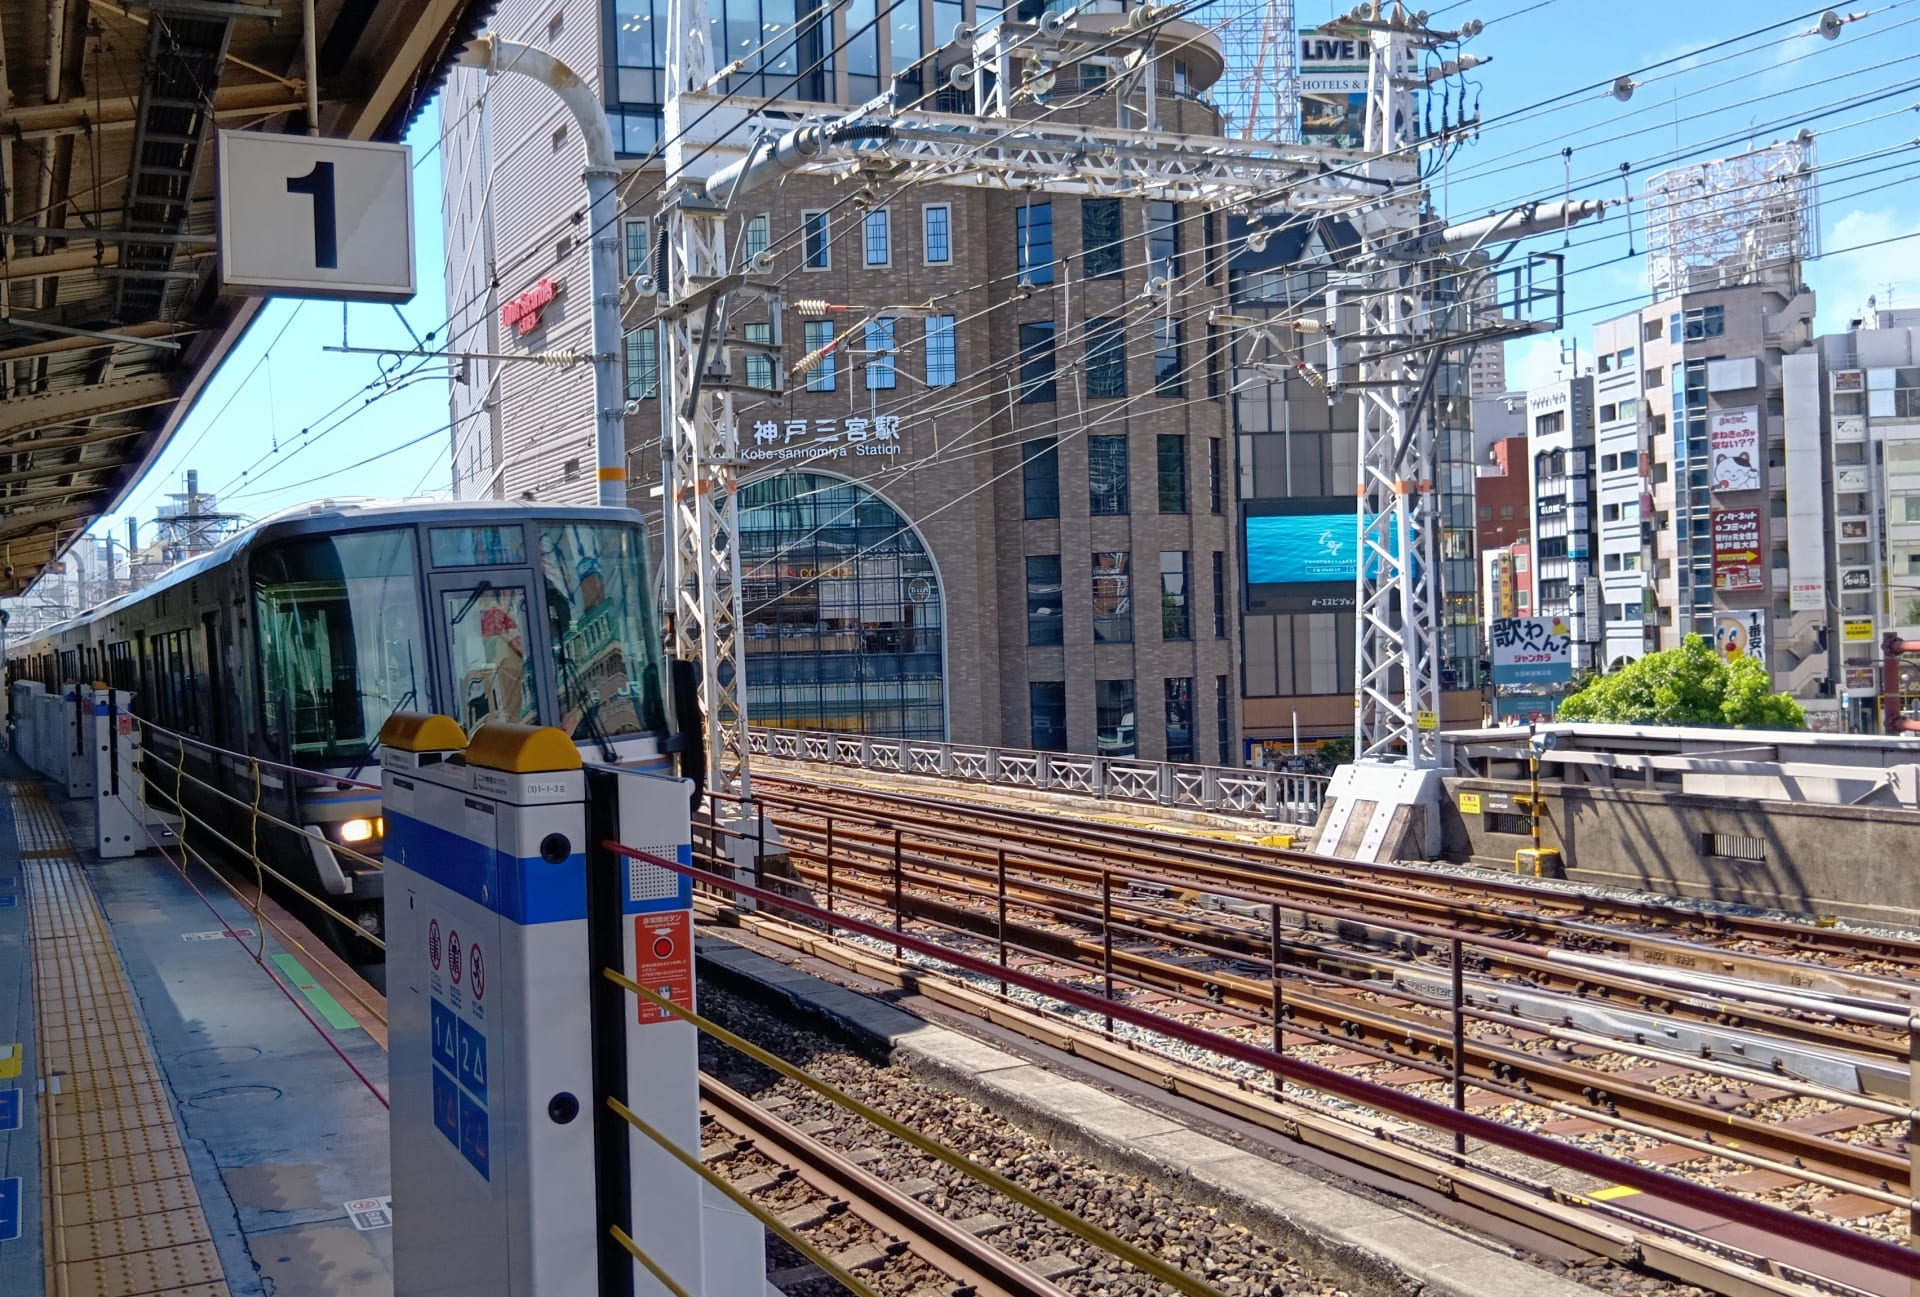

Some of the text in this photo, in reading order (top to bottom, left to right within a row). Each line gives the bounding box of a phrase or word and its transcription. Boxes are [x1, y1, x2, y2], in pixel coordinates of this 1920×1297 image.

[1303, 80, 1348, 90] HOTELS
[1352, 80, 1360, 90] &
[286, 161, 337, 268] 1
[753, 415, 900, 445] 神戸三宮駅
[741, 445, 847, 460] Kobe-sannomiya
[856, 443, 900, 457] Station
[1513, 653, 1551, 663] ジャンカラ
